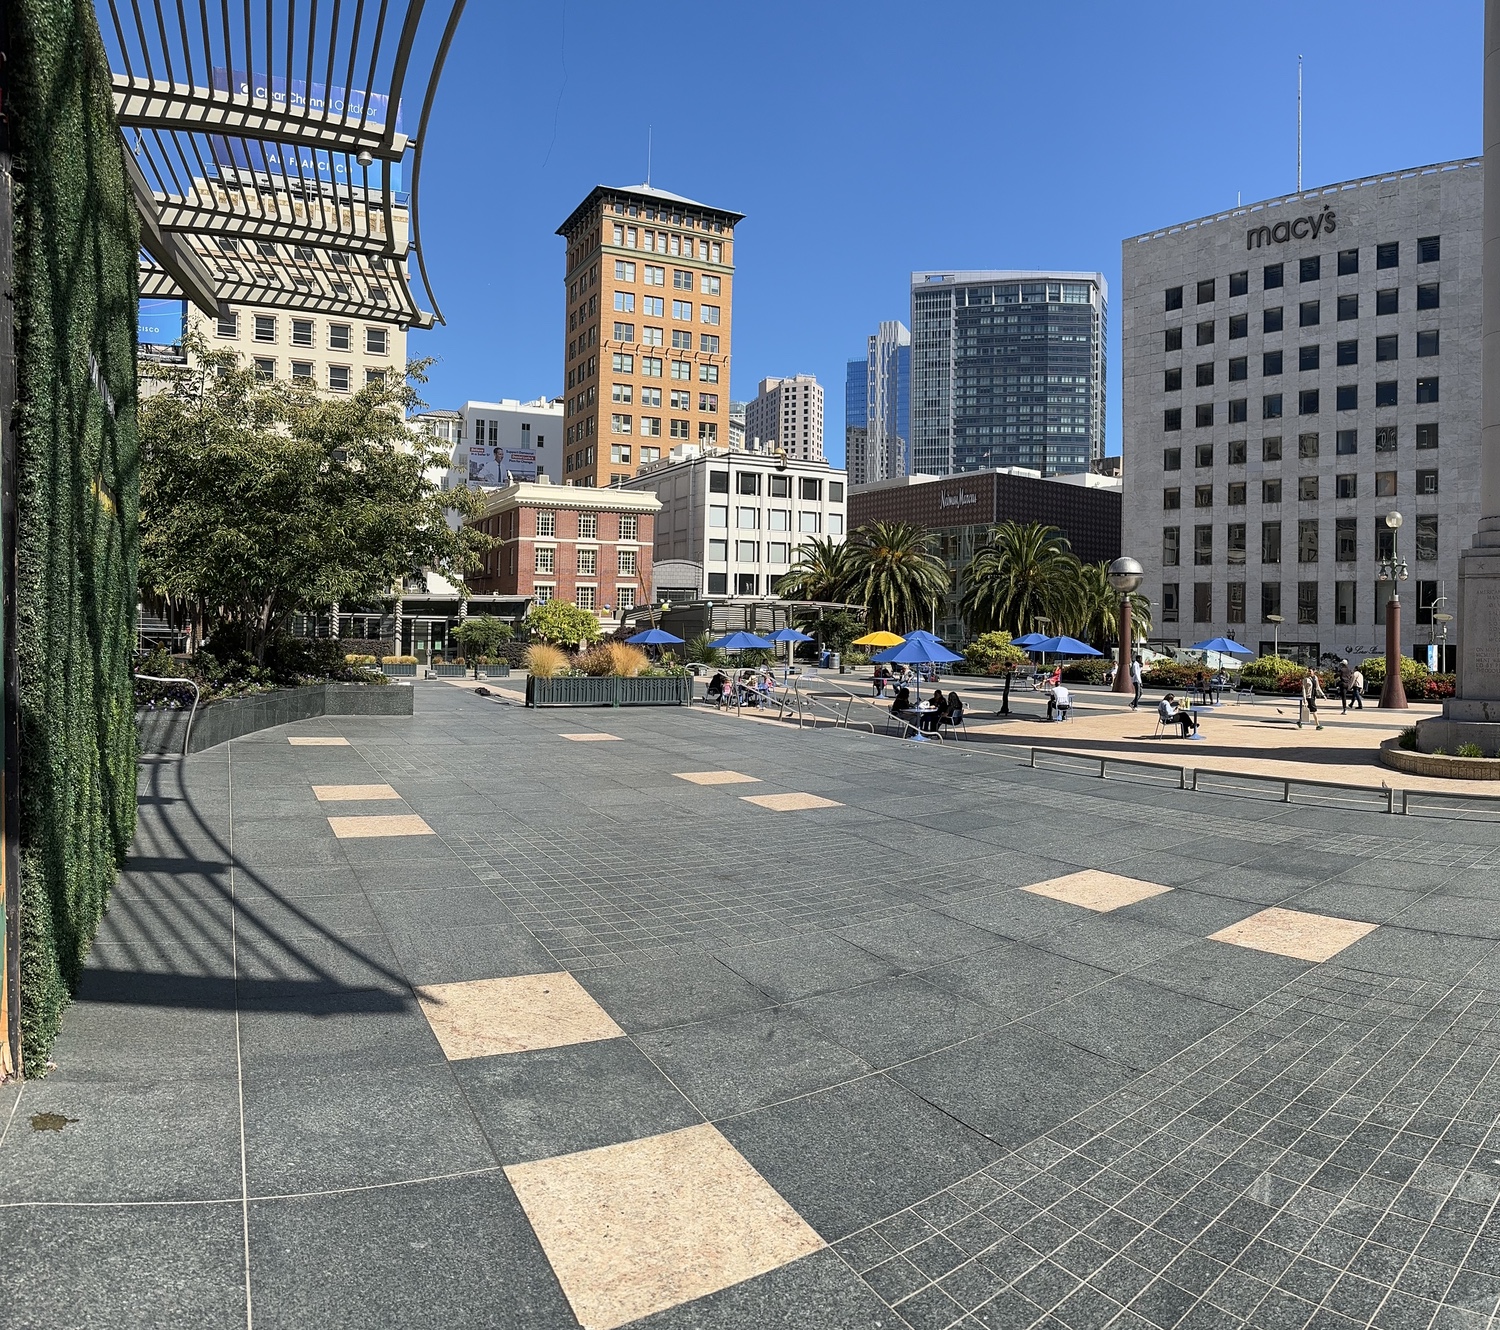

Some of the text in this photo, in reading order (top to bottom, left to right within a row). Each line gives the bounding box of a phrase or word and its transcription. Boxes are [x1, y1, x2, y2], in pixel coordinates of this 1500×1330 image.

[334, 99, 377, 116] Otdor
[289, 157, 353, 173] FACIC
[1247, 204, 1336, 250] macy's
